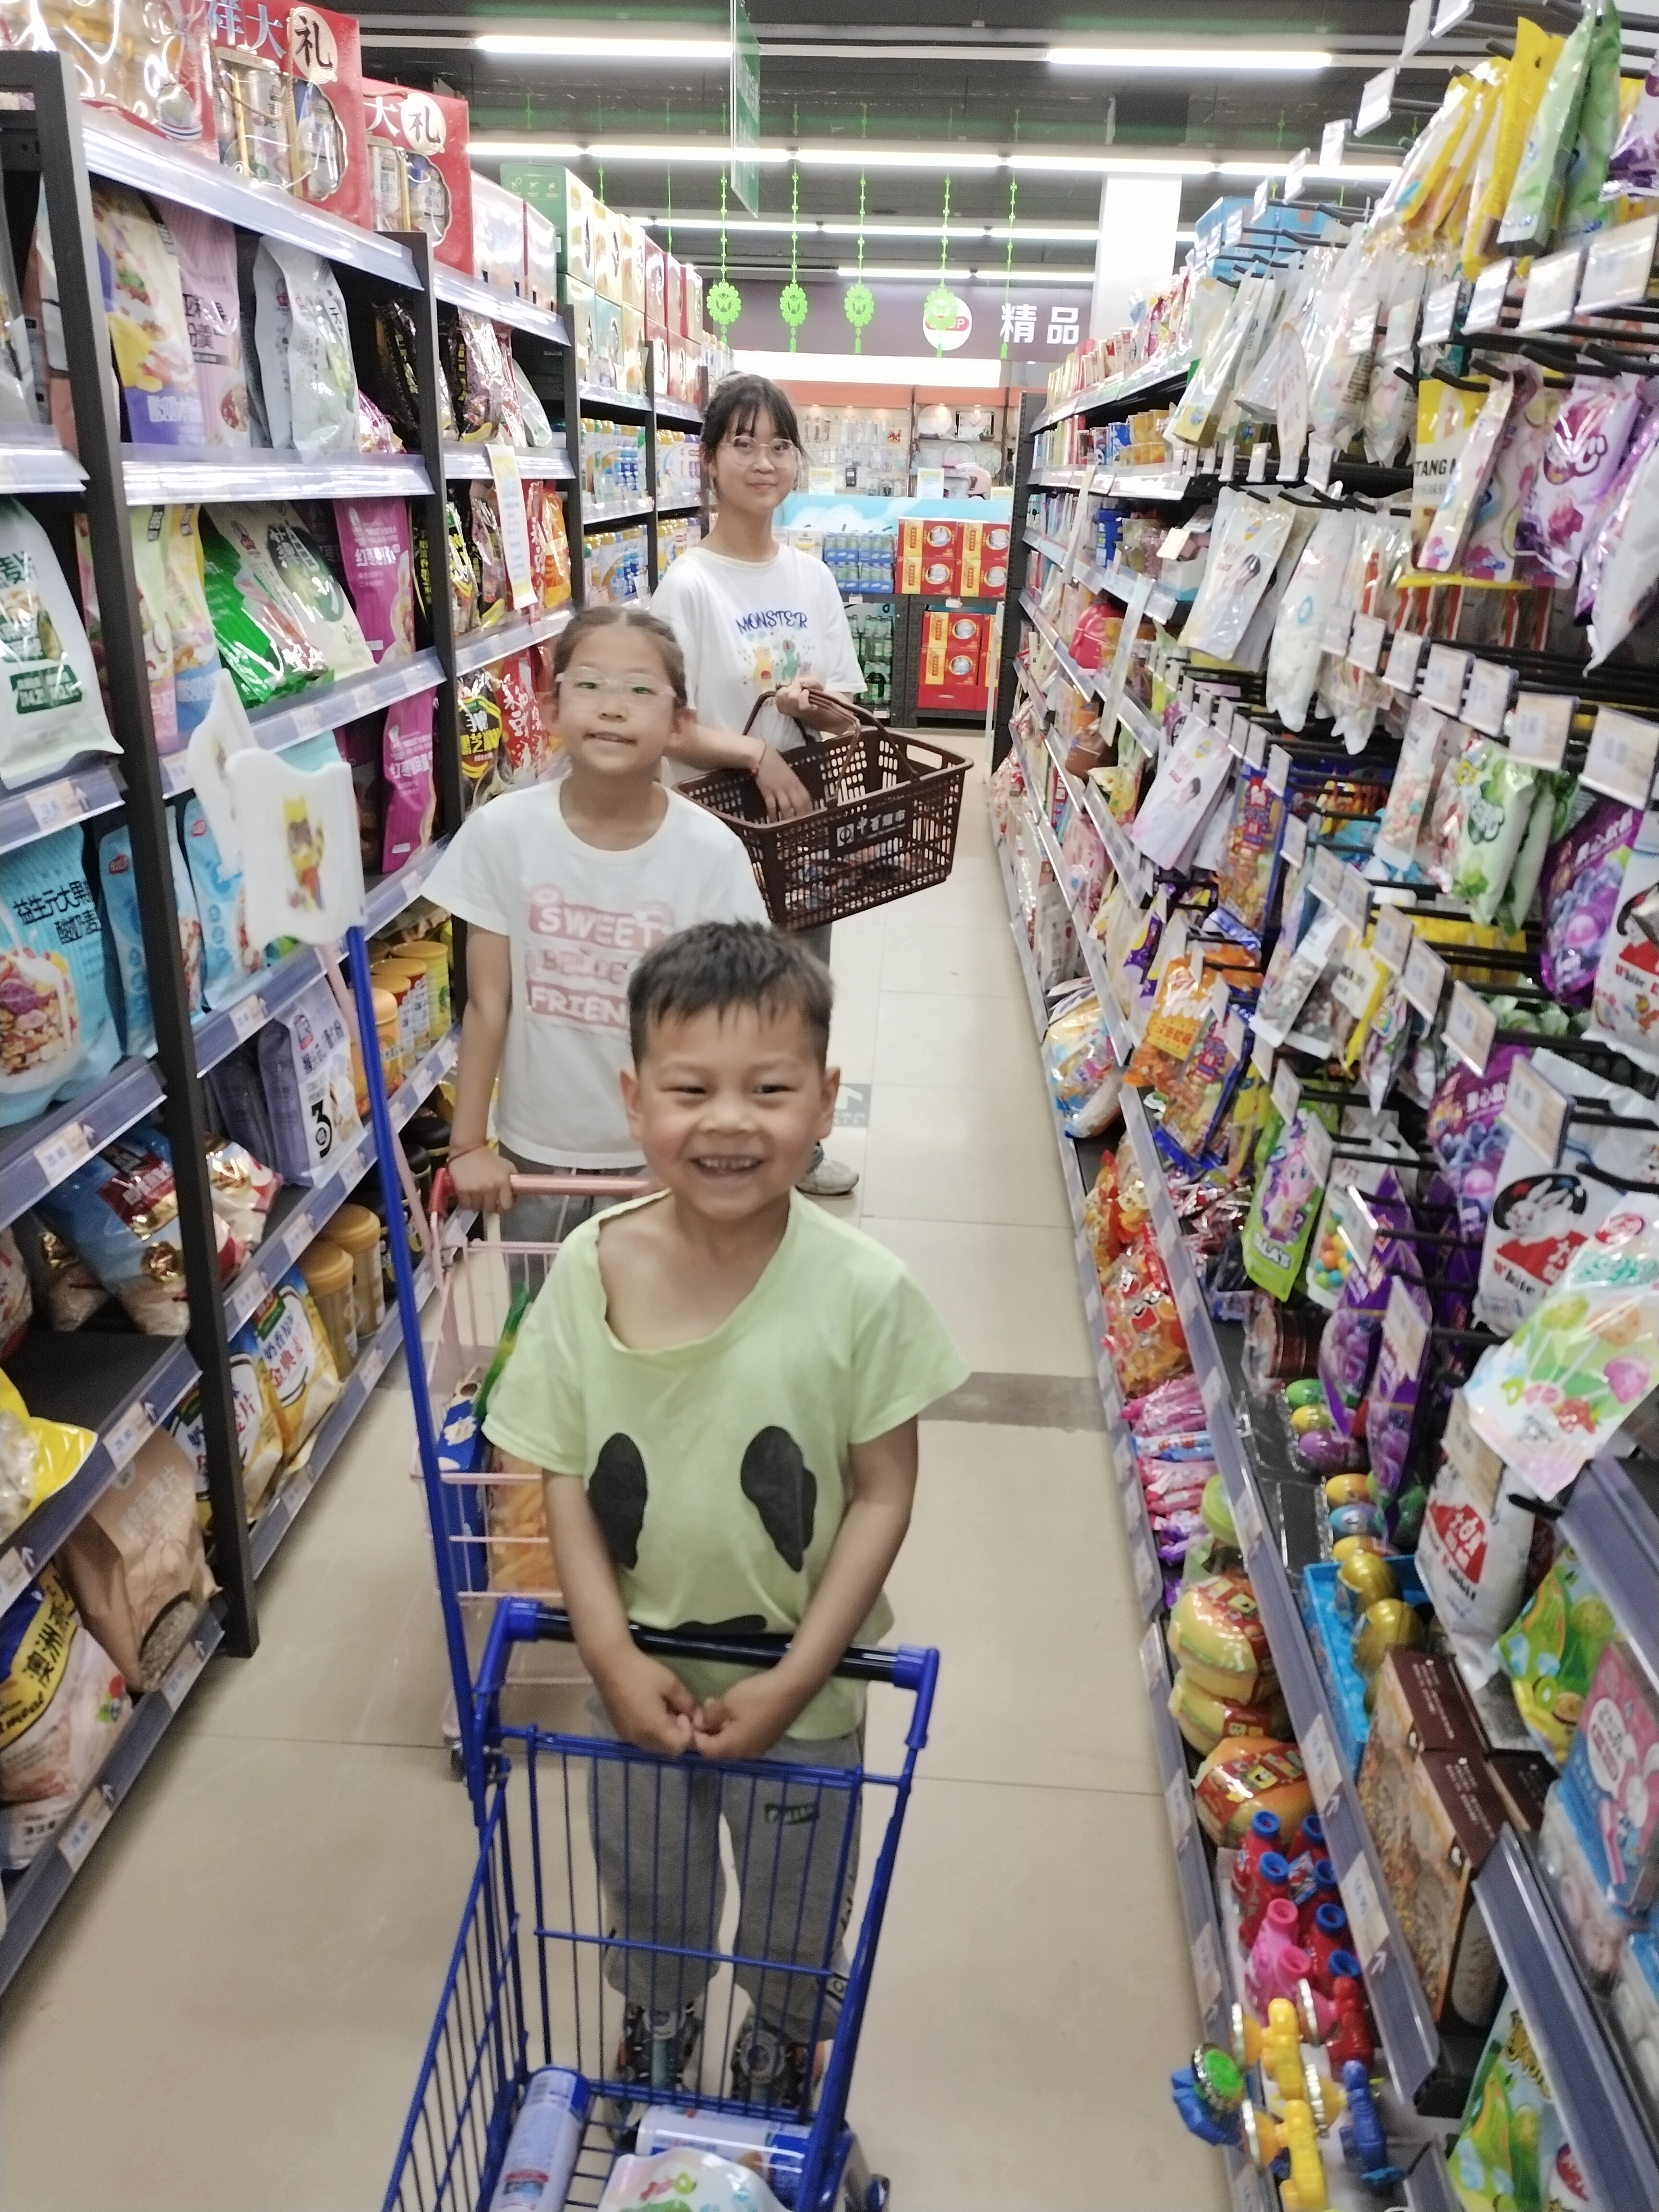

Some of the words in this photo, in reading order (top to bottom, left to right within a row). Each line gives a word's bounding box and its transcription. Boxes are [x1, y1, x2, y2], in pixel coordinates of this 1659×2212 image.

[1000, 304, 1080, 345] 精品
[736, 610, 807, 635] MONSTER
[538, 907, 661, 949] SWEET
[531, 986, 629, 1024] FRIEN
